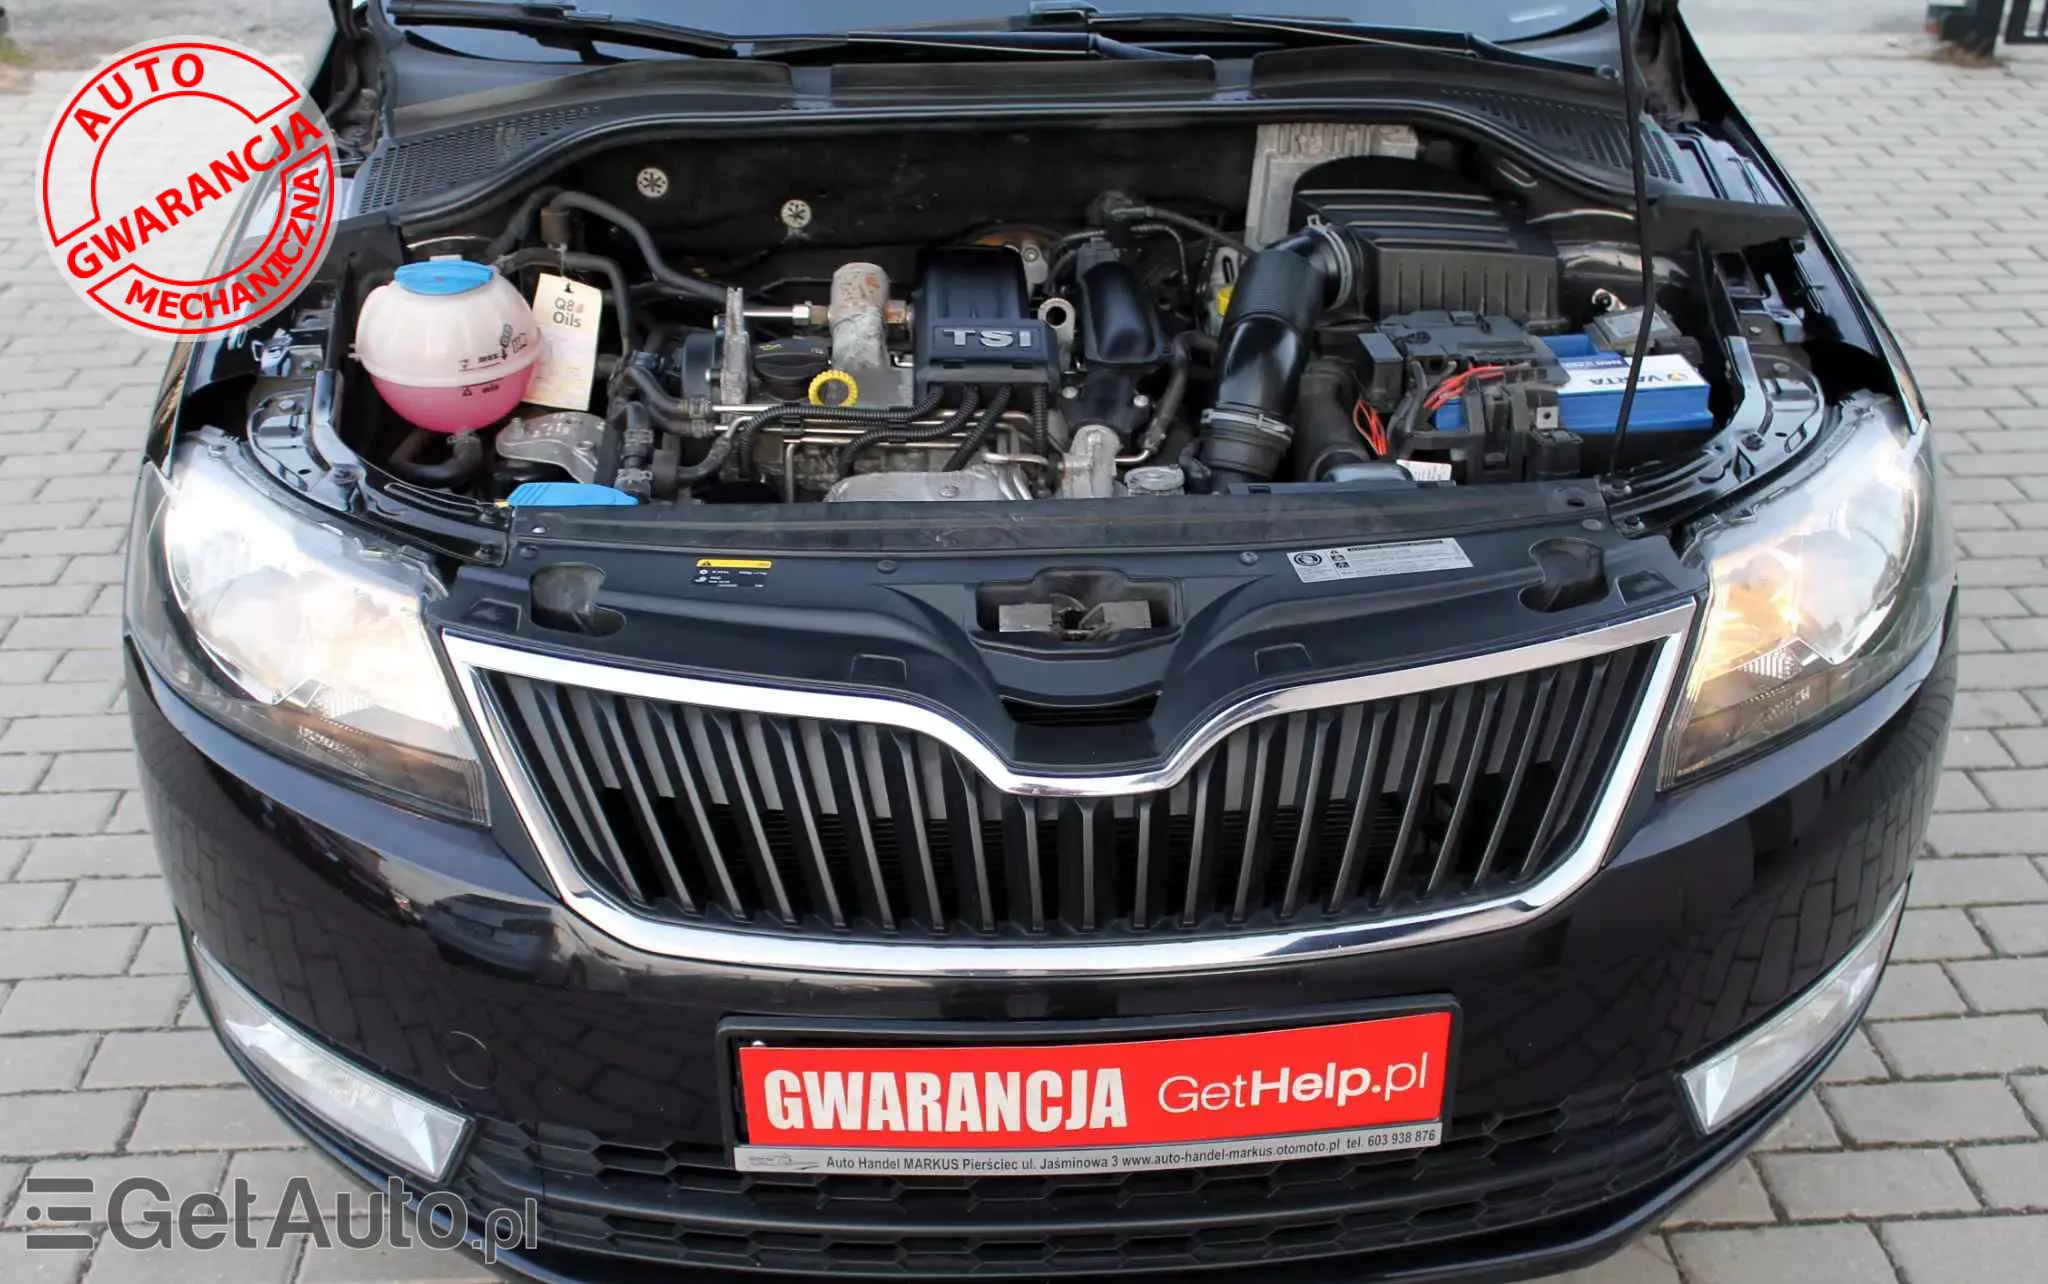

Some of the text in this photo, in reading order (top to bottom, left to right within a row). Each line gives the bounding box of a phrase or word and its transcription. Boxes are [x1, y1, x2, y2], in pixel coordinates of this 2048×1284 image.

[554, 296, 575, 312] Q8
[552, 311, 582, 328] Oils
[943, 328, 1032, 347] TSI
[764, 1052, 1429, 1132] GWARANCJA GetHelp.pl
[826, 1129, 1436, 1171] Auto Handel MARKUS Pierściec ul. Jaśminowa 3 www.auto-handel-markus.otomoto.pl tel. 603 938 876
